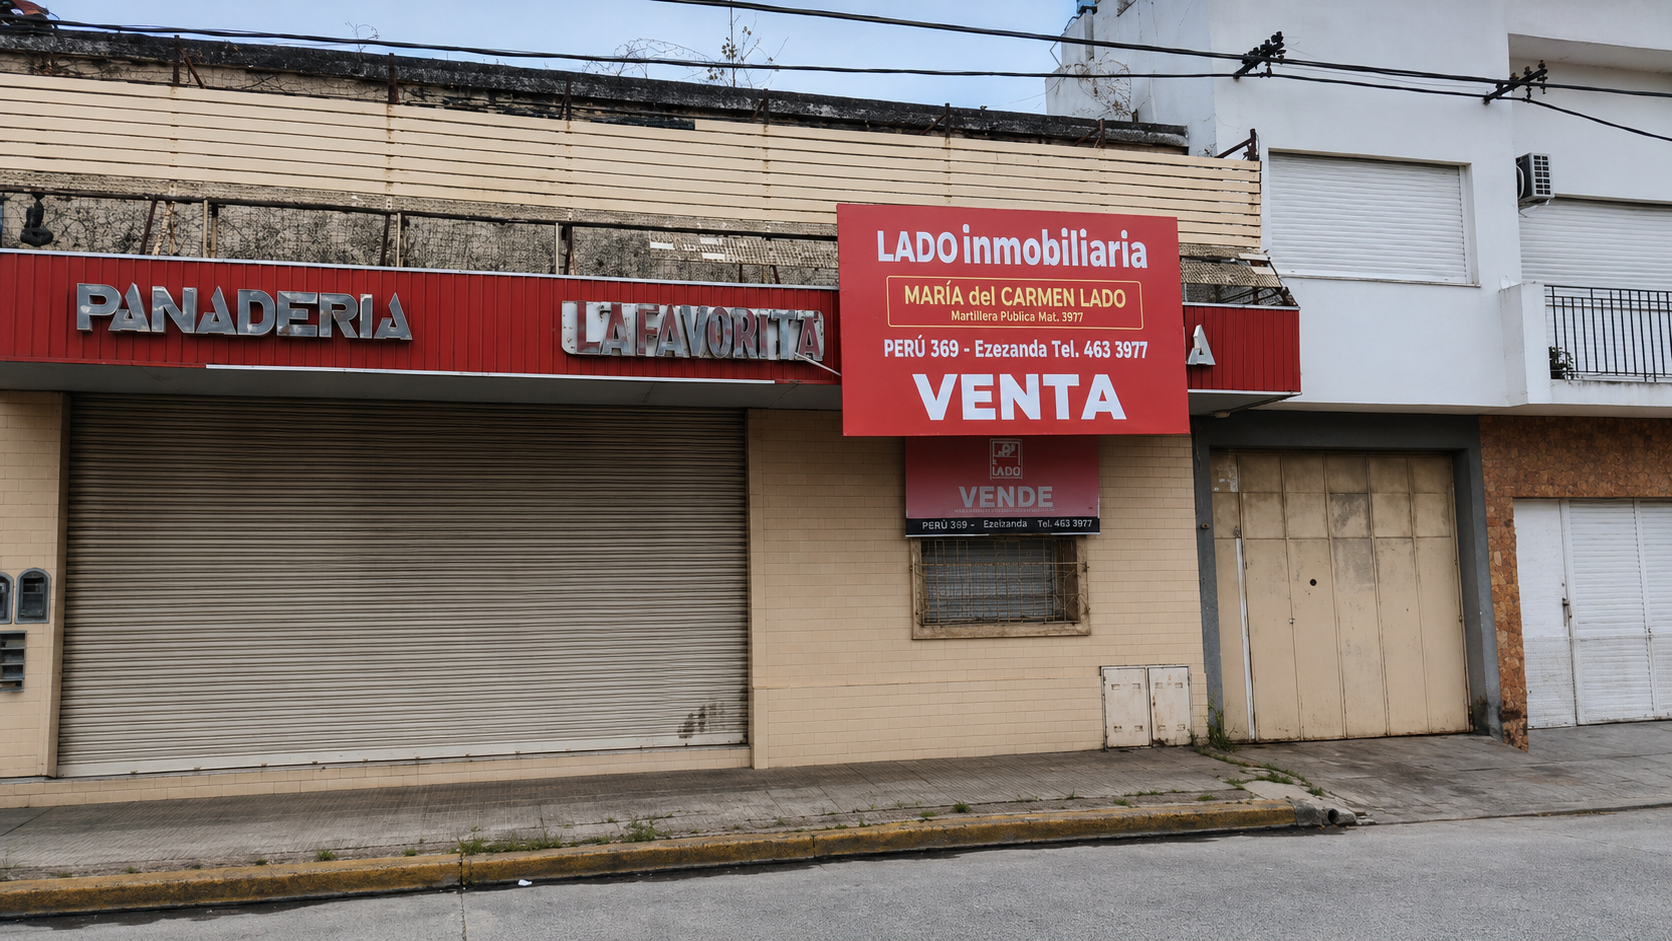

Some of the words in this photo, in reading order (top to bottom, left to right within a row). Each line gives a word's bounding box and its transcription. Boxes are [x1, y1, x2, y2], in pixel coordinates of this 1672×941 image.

[877, 230, 958, 264] LADO
[962, 224, 1149, 269] inmobiliaria
[904, 280, 964, 306] MARÍA
[969, 285, 996, 306] del
[1001, 287, 1075, 307] CARMEN
[1080, 288, 1127, 309] LADO
[76, 282, 413, 341] PANADERIA
[951, 309, 998, 322] Martillera
[1038, 311, 1060, 323] Mat.
[1062, 312, 1084, 323] 3977
[884, 334, 926, 358] PERÚ
[931, 339, 959, 358] 369
[975, 339, 1048, 359] Ezezanda
[1052, 340, 1079, 359] Tel.
[1084, 341, 1112, 359] 463
[1115, 341, 1149, 359] 3977
[912, 373, 1128, 421] VENTA
[992, 466, 1021, 477] LADO
[959, 486, 1054, 508] VENDE
[950, 520, 968, 529] 369
[1054, 518, 1071, 528] 463
[1073, 518, 1093, 528] 3977
